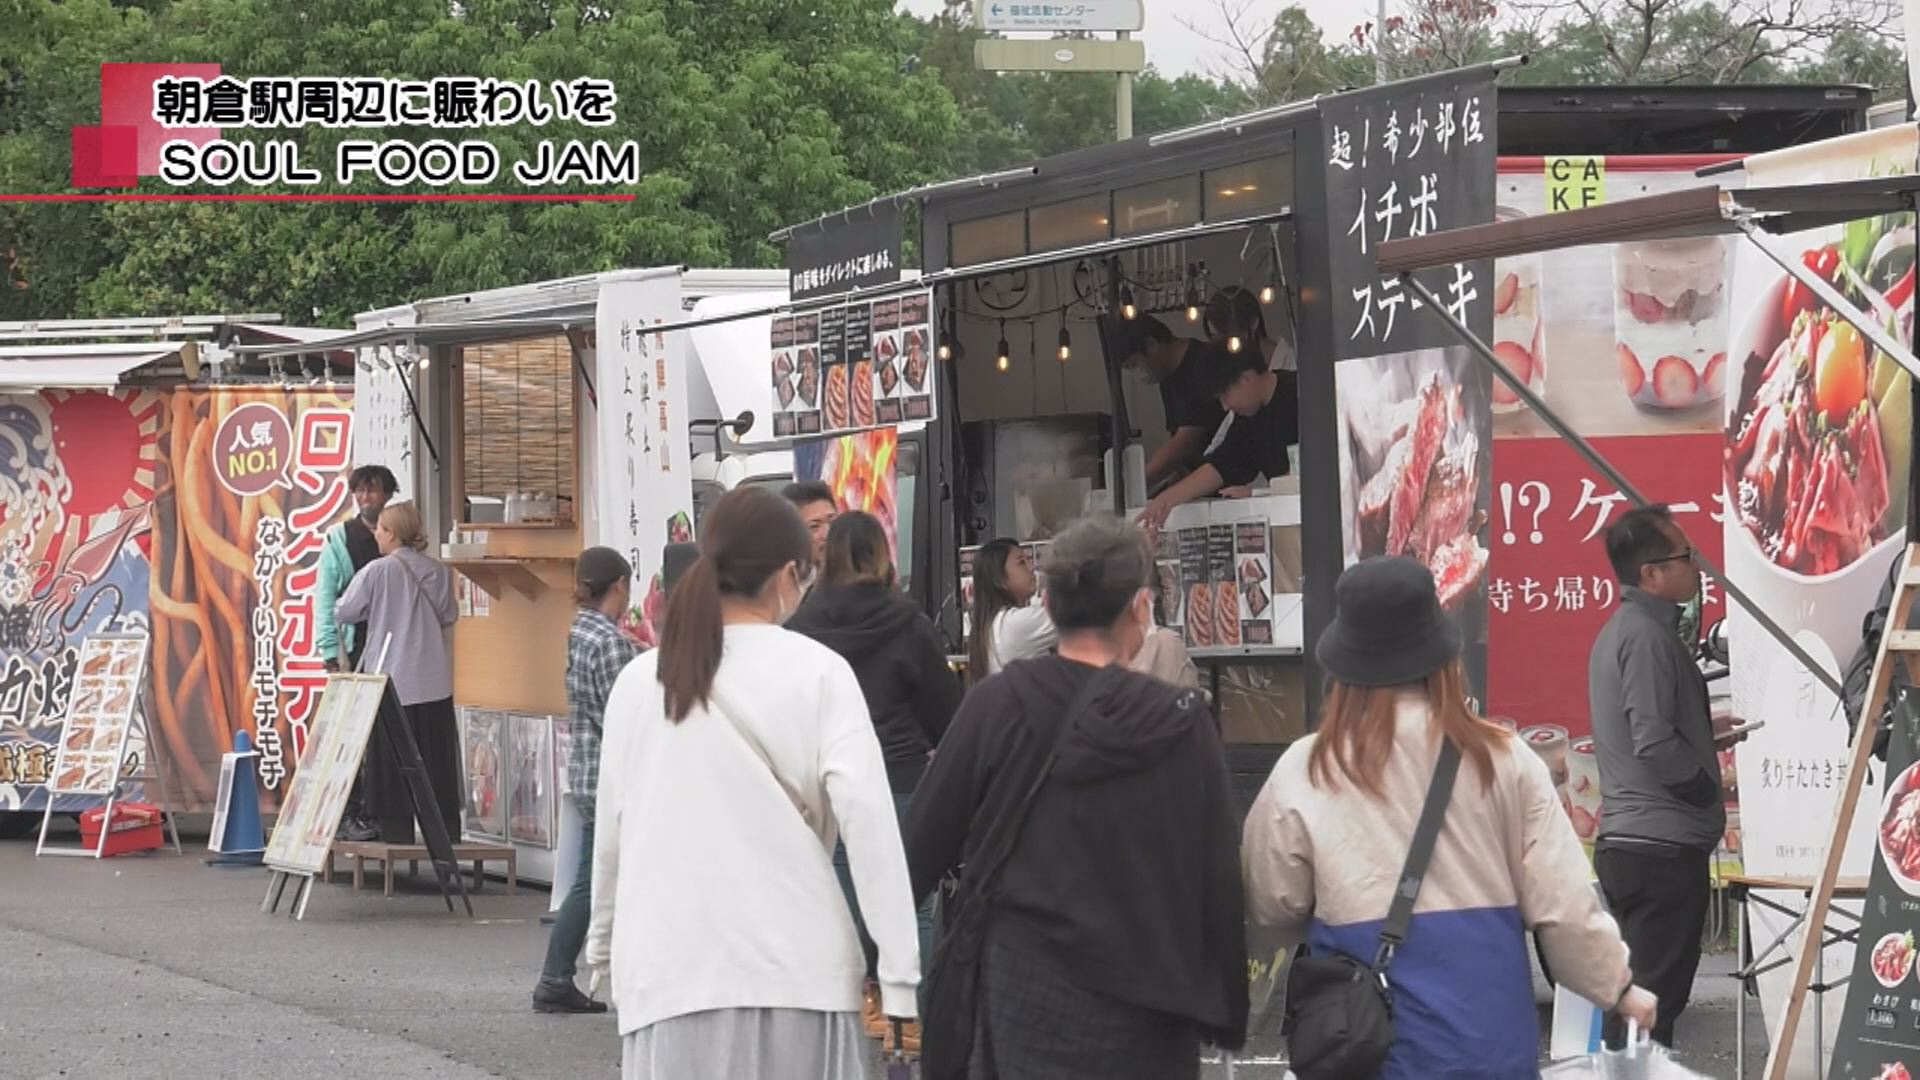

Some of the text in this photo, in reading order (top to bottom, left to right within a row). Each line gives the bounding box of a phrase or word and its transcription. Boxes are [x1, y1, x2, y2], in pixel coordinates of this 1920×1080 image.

[1009, 4, 1097, 17] 福祉活動センター
[1347, 172, 1439, 255] イチボ
[1350, 262, 1478, 343] ステーキ
[228, 420, 274, 453] 人気
[228, 447, 278, 479] NO.1
